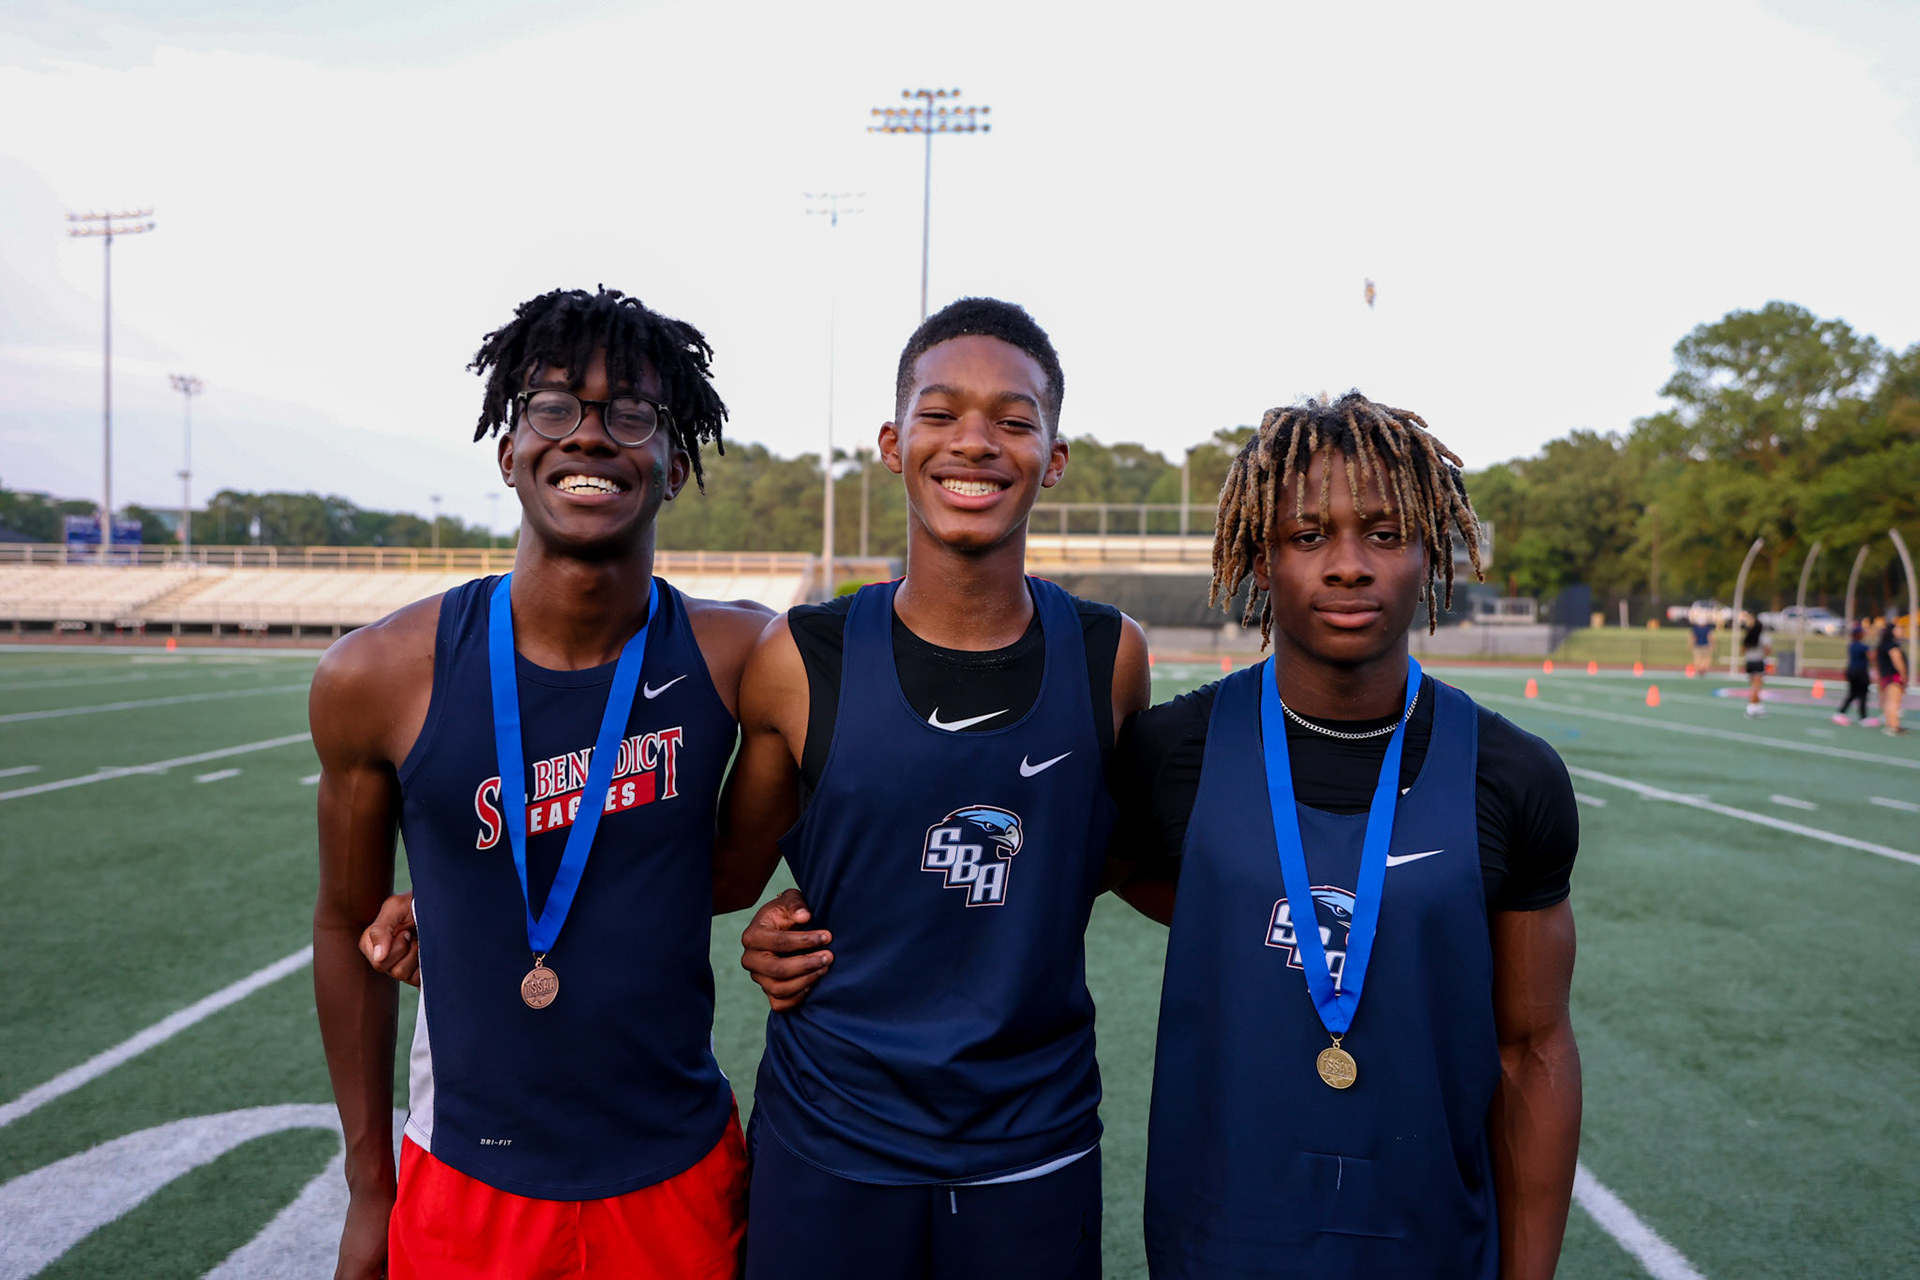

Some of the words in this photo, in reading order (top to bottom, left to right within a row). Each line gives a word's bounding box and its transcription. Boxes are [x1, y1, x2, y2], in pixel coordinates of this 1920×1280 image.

[532, 726, 684, 800] BENDICT
[530, 781, 636, 833] EAGES
[926, 827, 1007, 902] SBA
[480, 1138, 512, 1146] DRI-FIT
